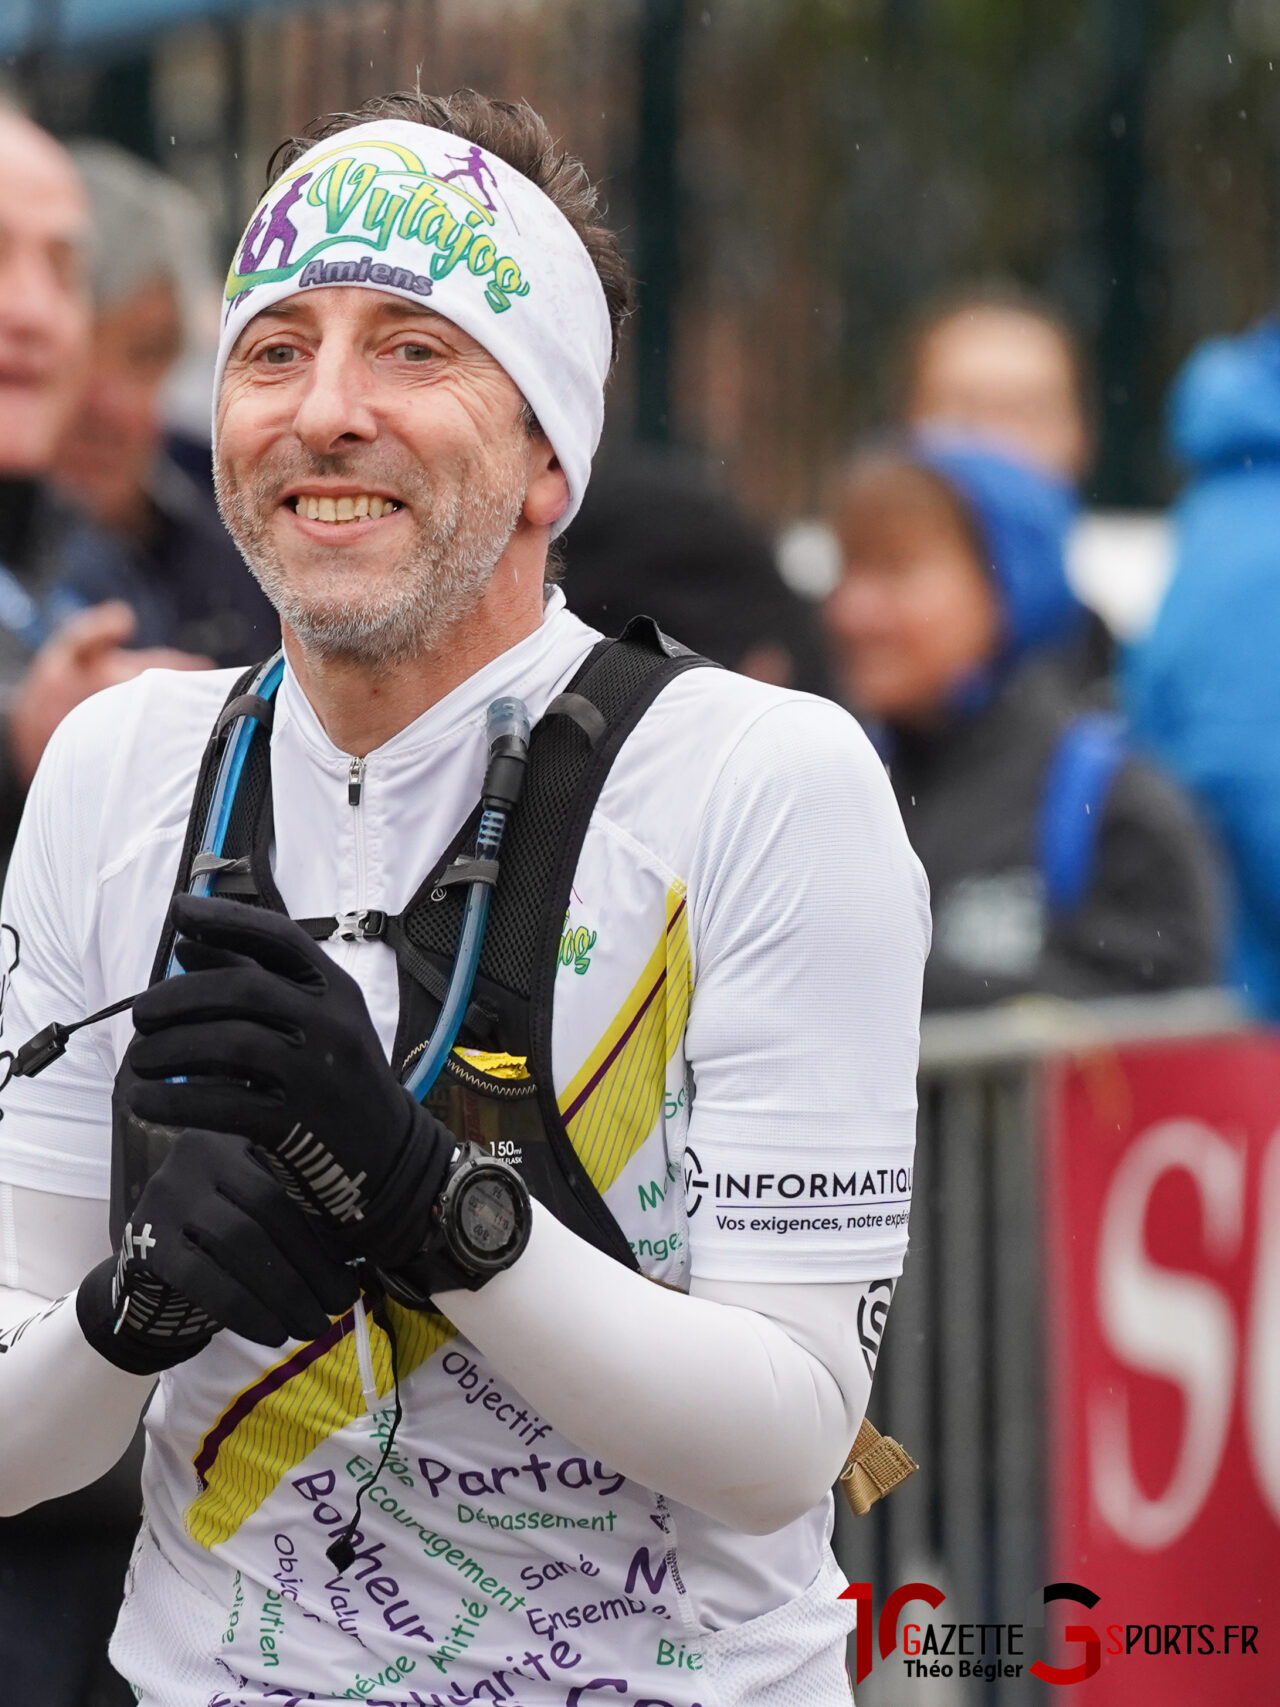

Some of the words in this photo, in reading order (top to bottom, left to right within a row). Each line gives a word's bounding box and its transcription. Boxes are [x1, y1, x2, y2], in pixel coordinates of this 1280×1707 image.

[306, 157, 530, 314] Vytajog
[298, 256, 433, 297] Amiens
[716, 1215, 745, 1231] Vos
[750, 1216, 843, 1235] exigences,
[847, 1213, 883, 1230] notre
[442, 1351, 552, 1446] Objectif
